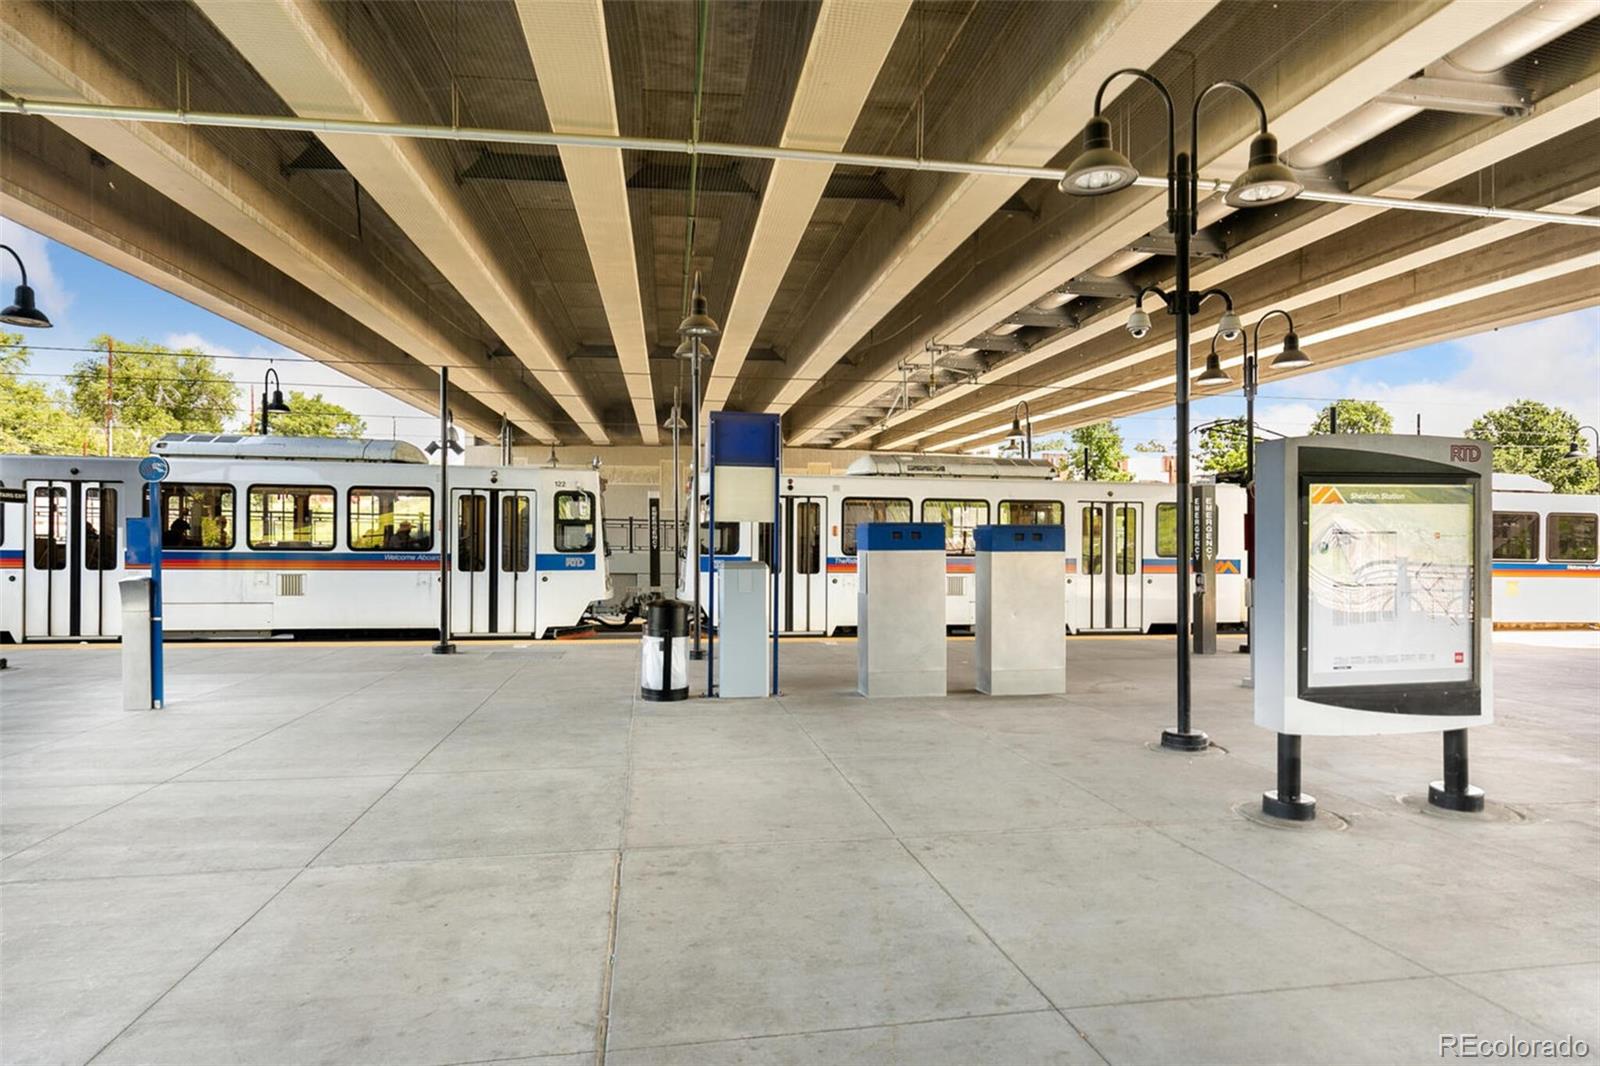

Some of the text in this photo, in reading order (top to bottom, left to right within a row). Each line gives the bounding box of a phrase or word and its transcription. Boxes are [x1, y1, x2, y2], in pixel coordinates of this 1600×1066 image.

[1450, 444, 1482, 463] RTD
[554, 480, 567, 488] 122
[1350, 492, 1406, 501] Sheridan Station
[1205, 497, 1213, 561] EMERGENCY
[384, 552, 417, 561] Welcome
[565, 557, 585, 567] RTD
